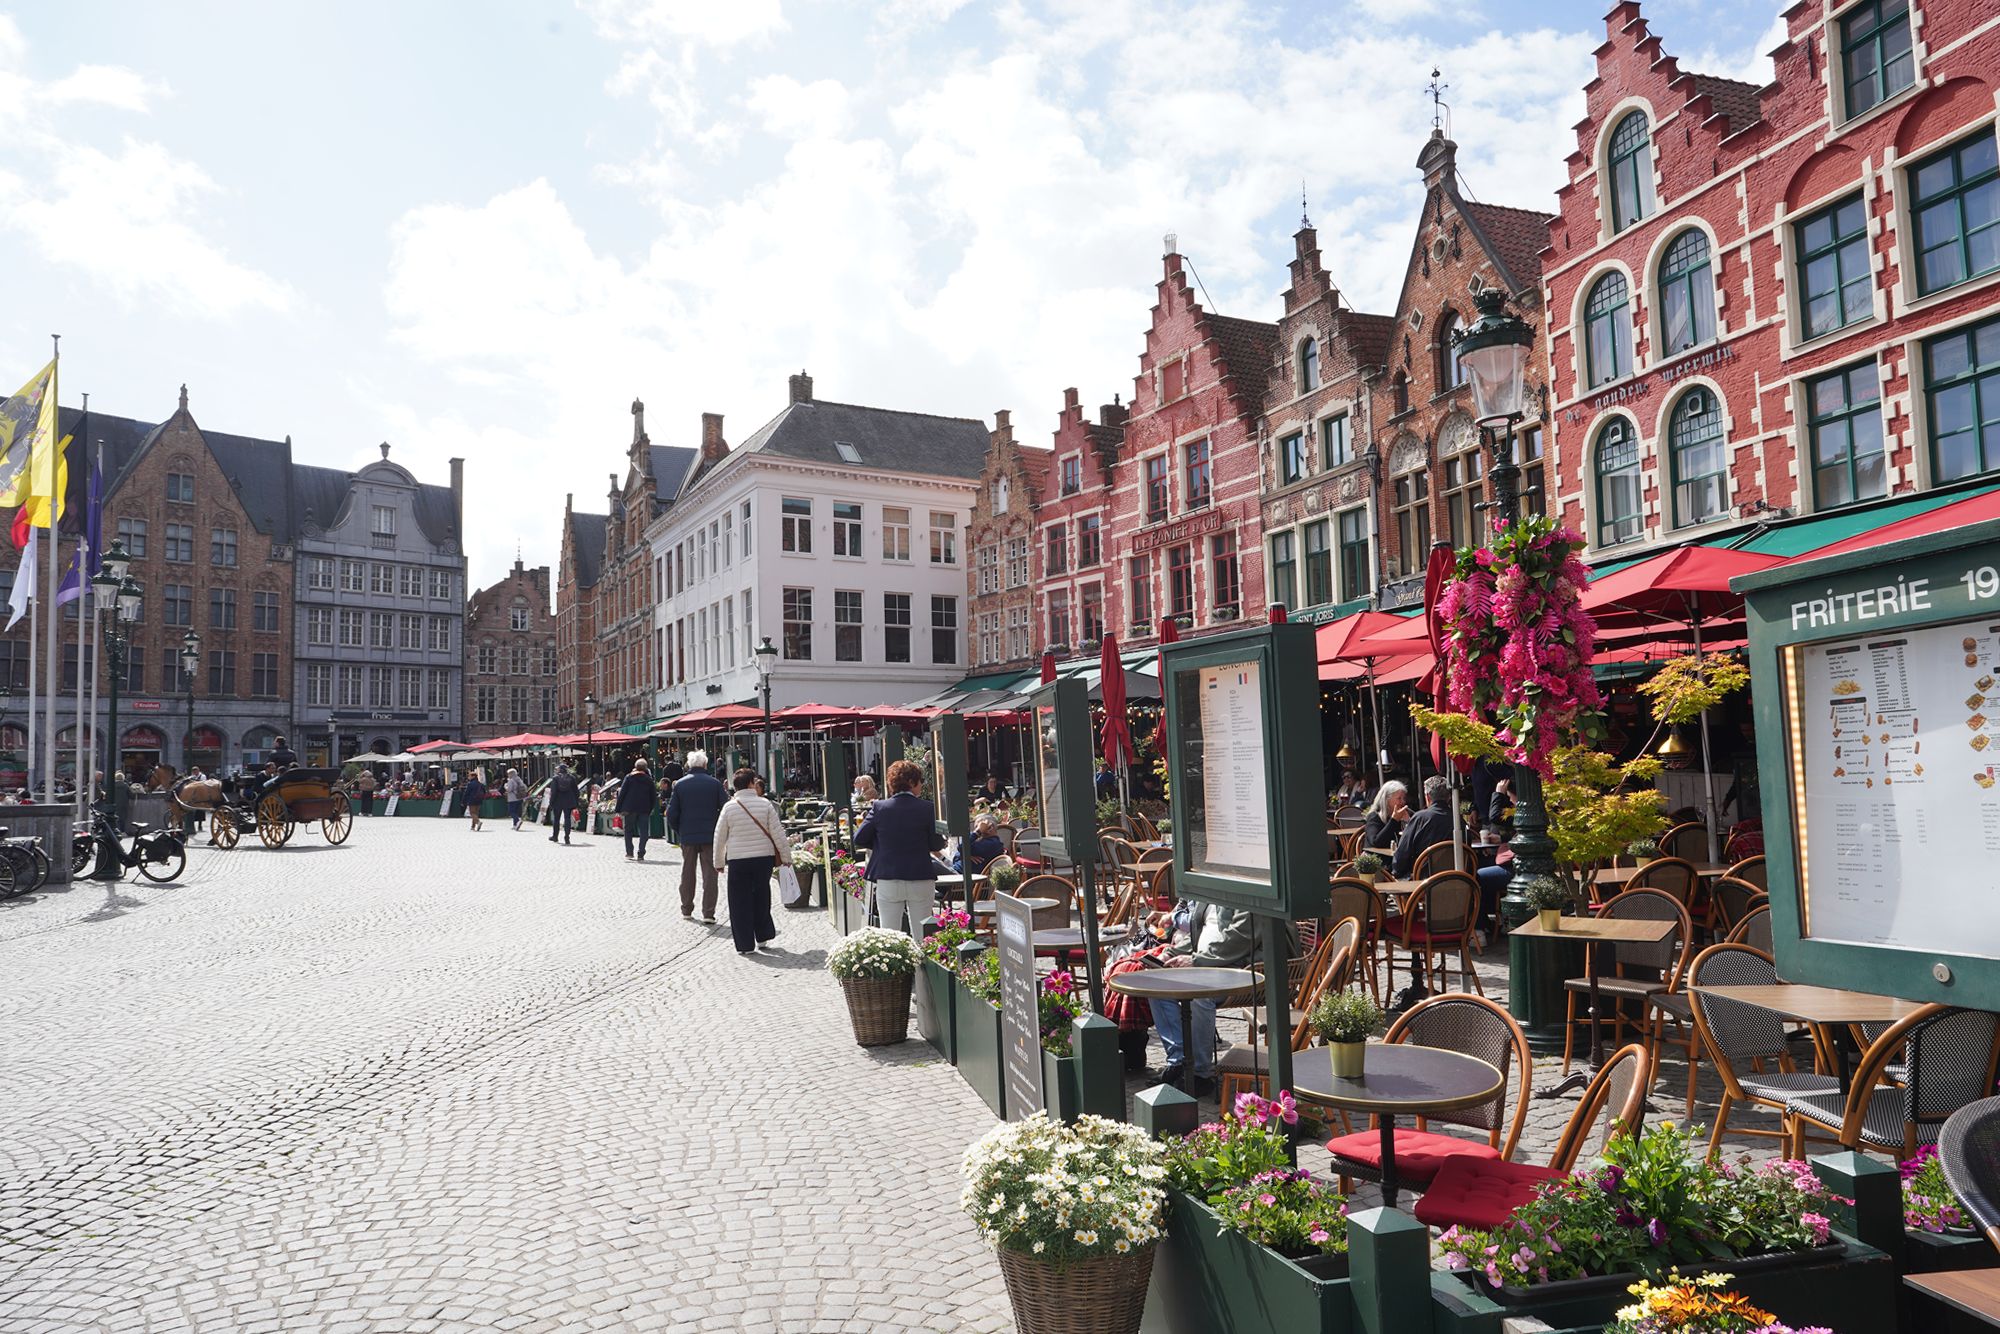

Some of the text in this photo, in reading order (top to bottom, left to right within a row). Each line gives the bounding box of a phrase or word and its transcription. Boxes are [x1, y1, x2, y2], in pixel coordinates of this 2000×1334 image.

[1136, 537, 1149, 550] LE
[1151, 523, 1188, 545] PANIER
[371, 712, 393, 720] fnac
